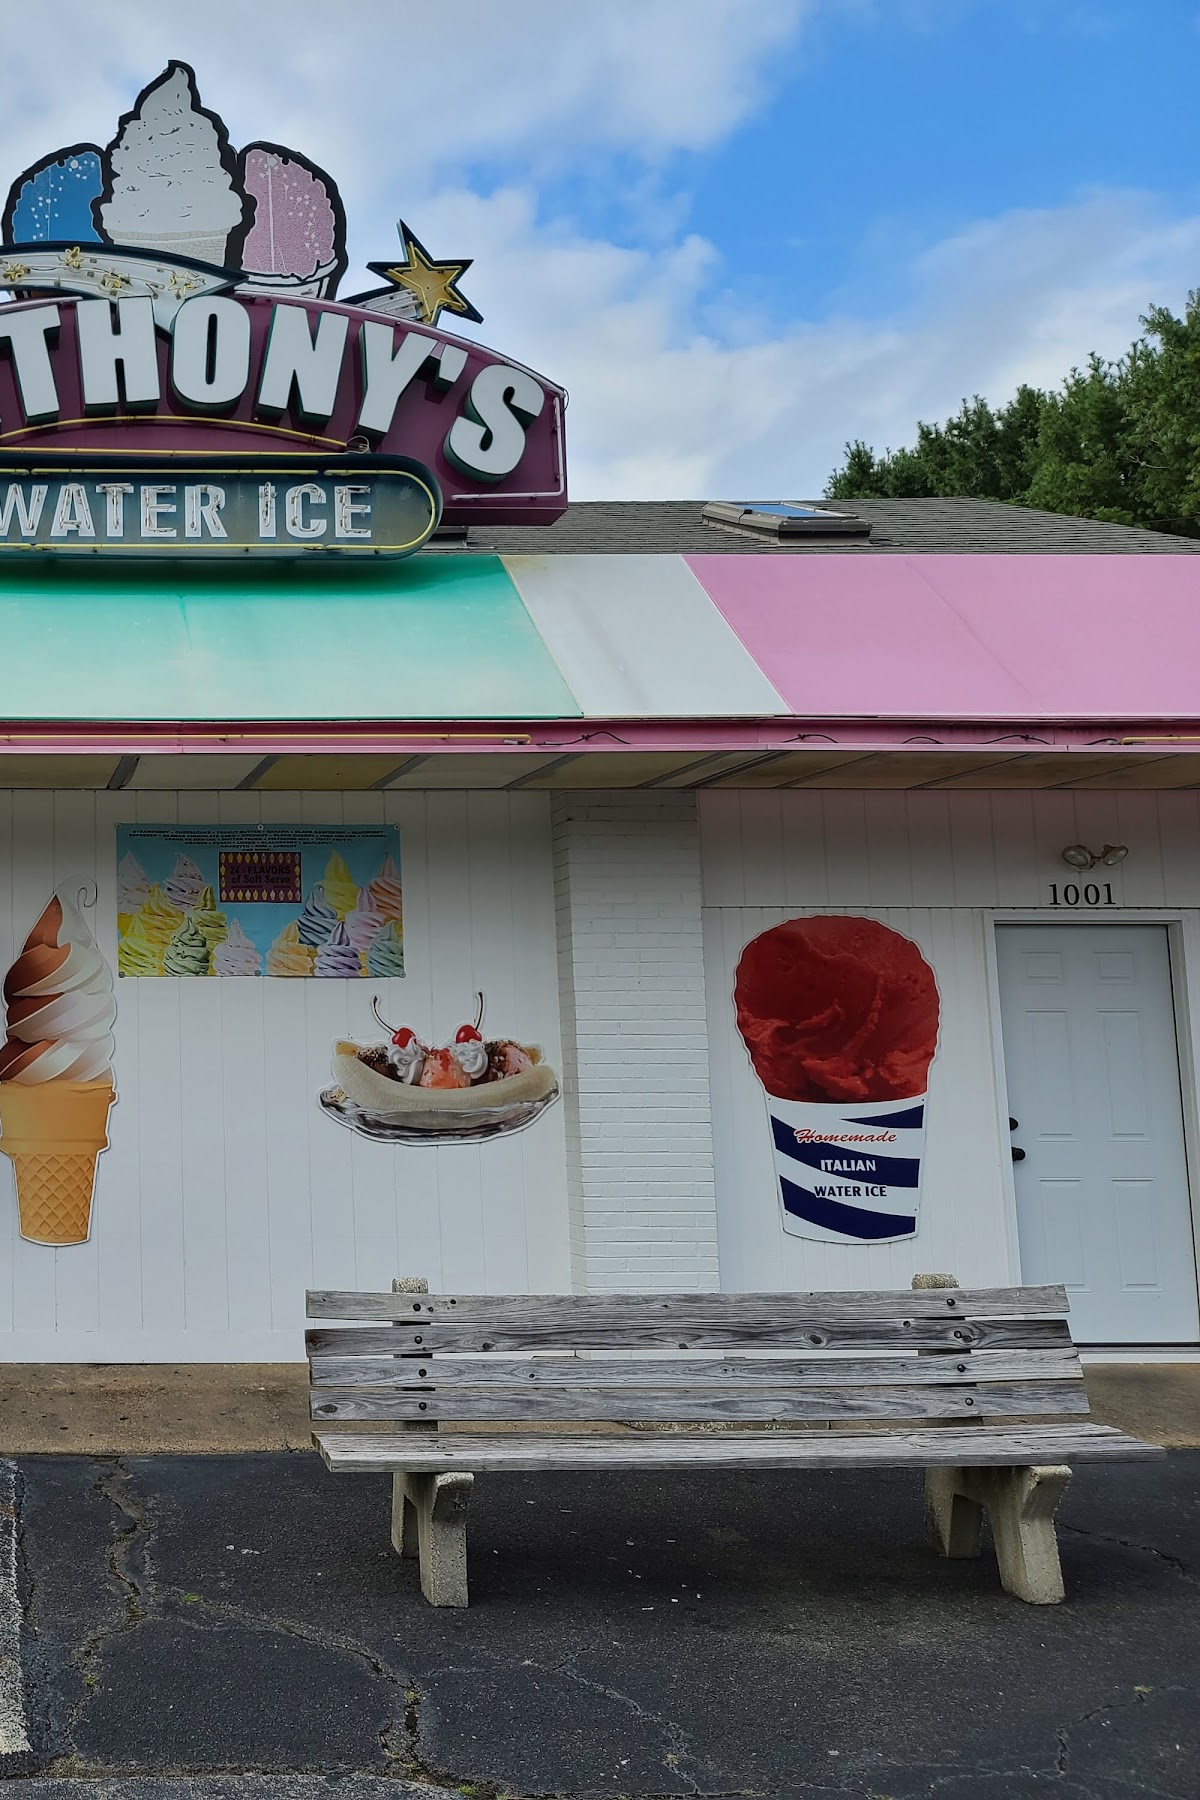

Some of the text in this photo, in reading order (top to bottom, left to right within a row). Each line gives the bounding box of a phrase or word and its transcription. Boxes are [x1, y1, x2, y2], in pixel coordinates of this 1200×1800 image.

[259, 483, 372, 538] ICE
[230, 866, 290, 874] 24 FLAVORS
[232, 875, 290, 884] of Soft Serve
[1048, 883, 1116, 906] 1001
[794, 1128, 898, 1143] Homemade
[820, 1160, 876, 1171] ITALIAN
[814, 1186, 887, 1197] WATER ICE
